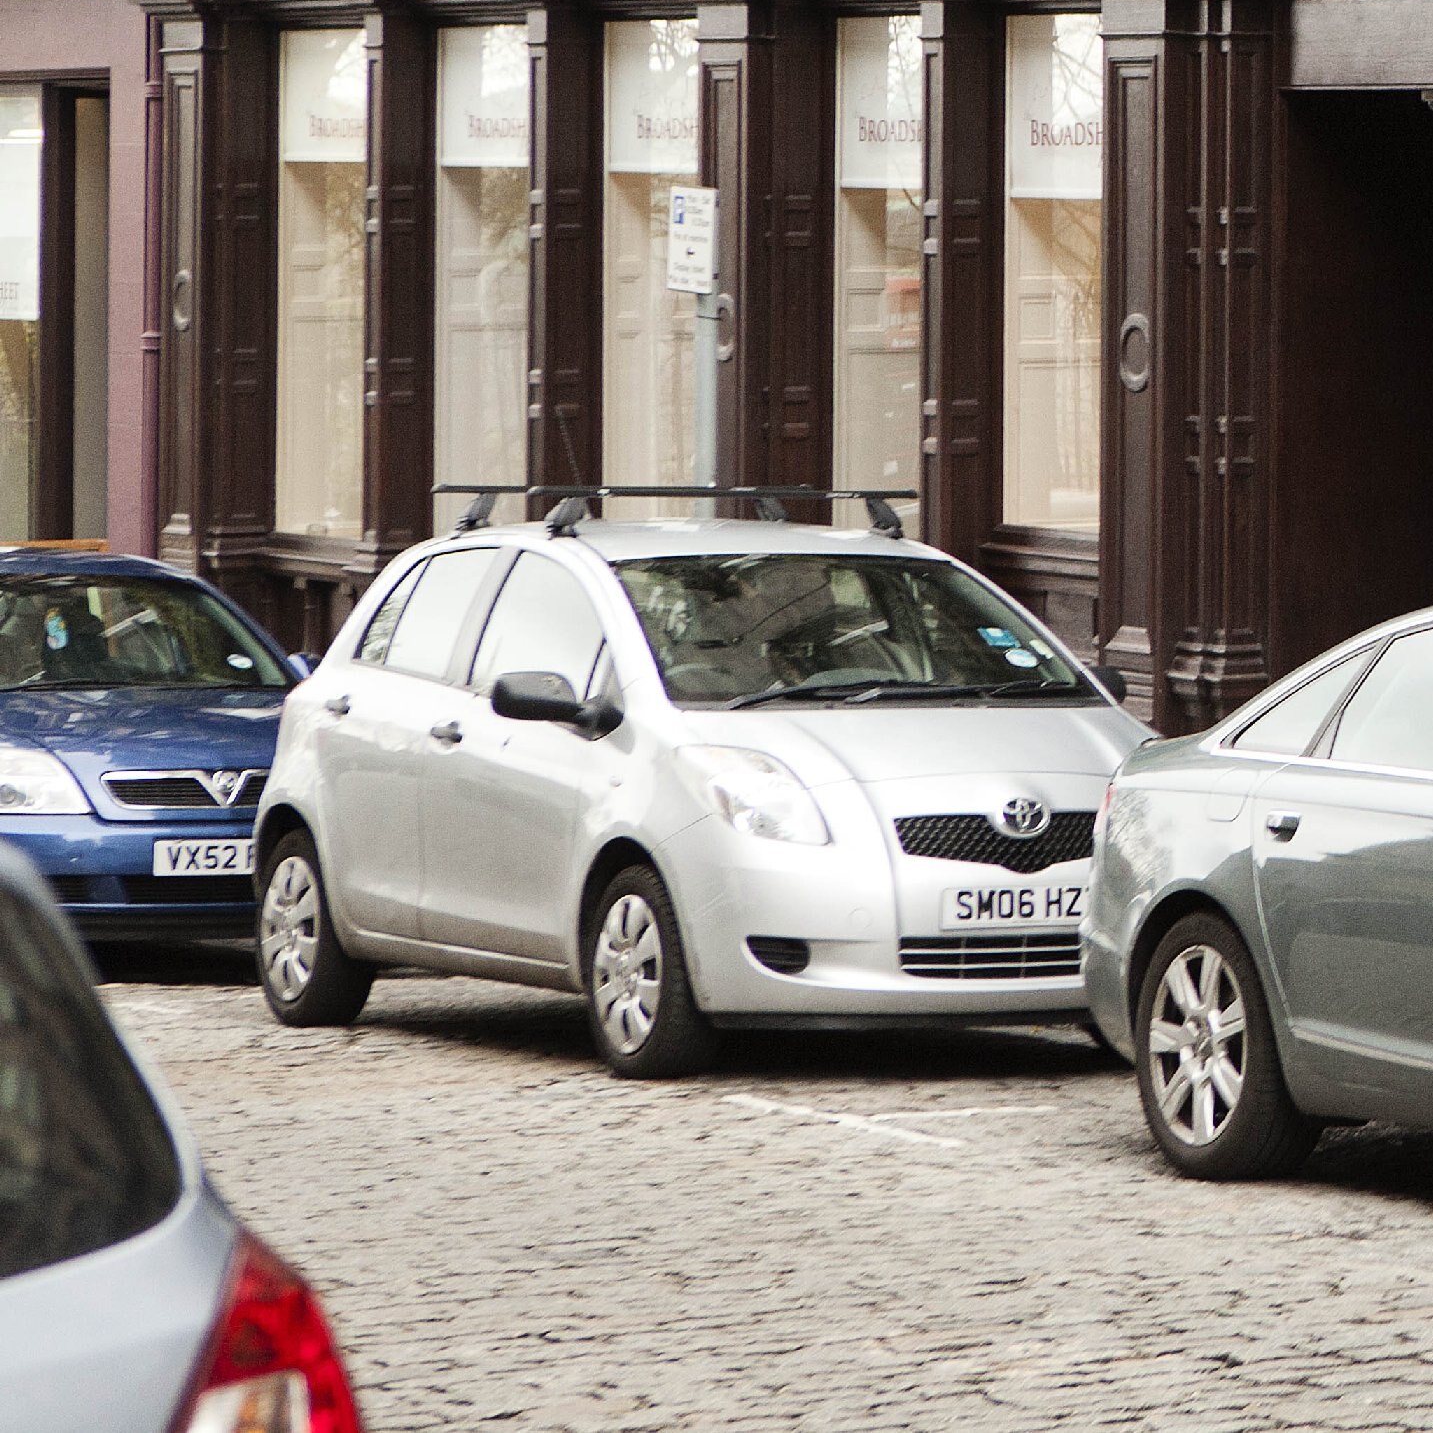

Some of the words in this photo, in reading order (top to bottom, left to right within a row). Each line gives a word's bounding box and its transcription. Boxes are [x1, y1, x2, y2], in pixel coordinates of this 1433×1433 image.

[167, 845, 237, 870] VX52
[956, 888, 1034, 920] SM06
[1045, 885, 1089, 918] HZ
